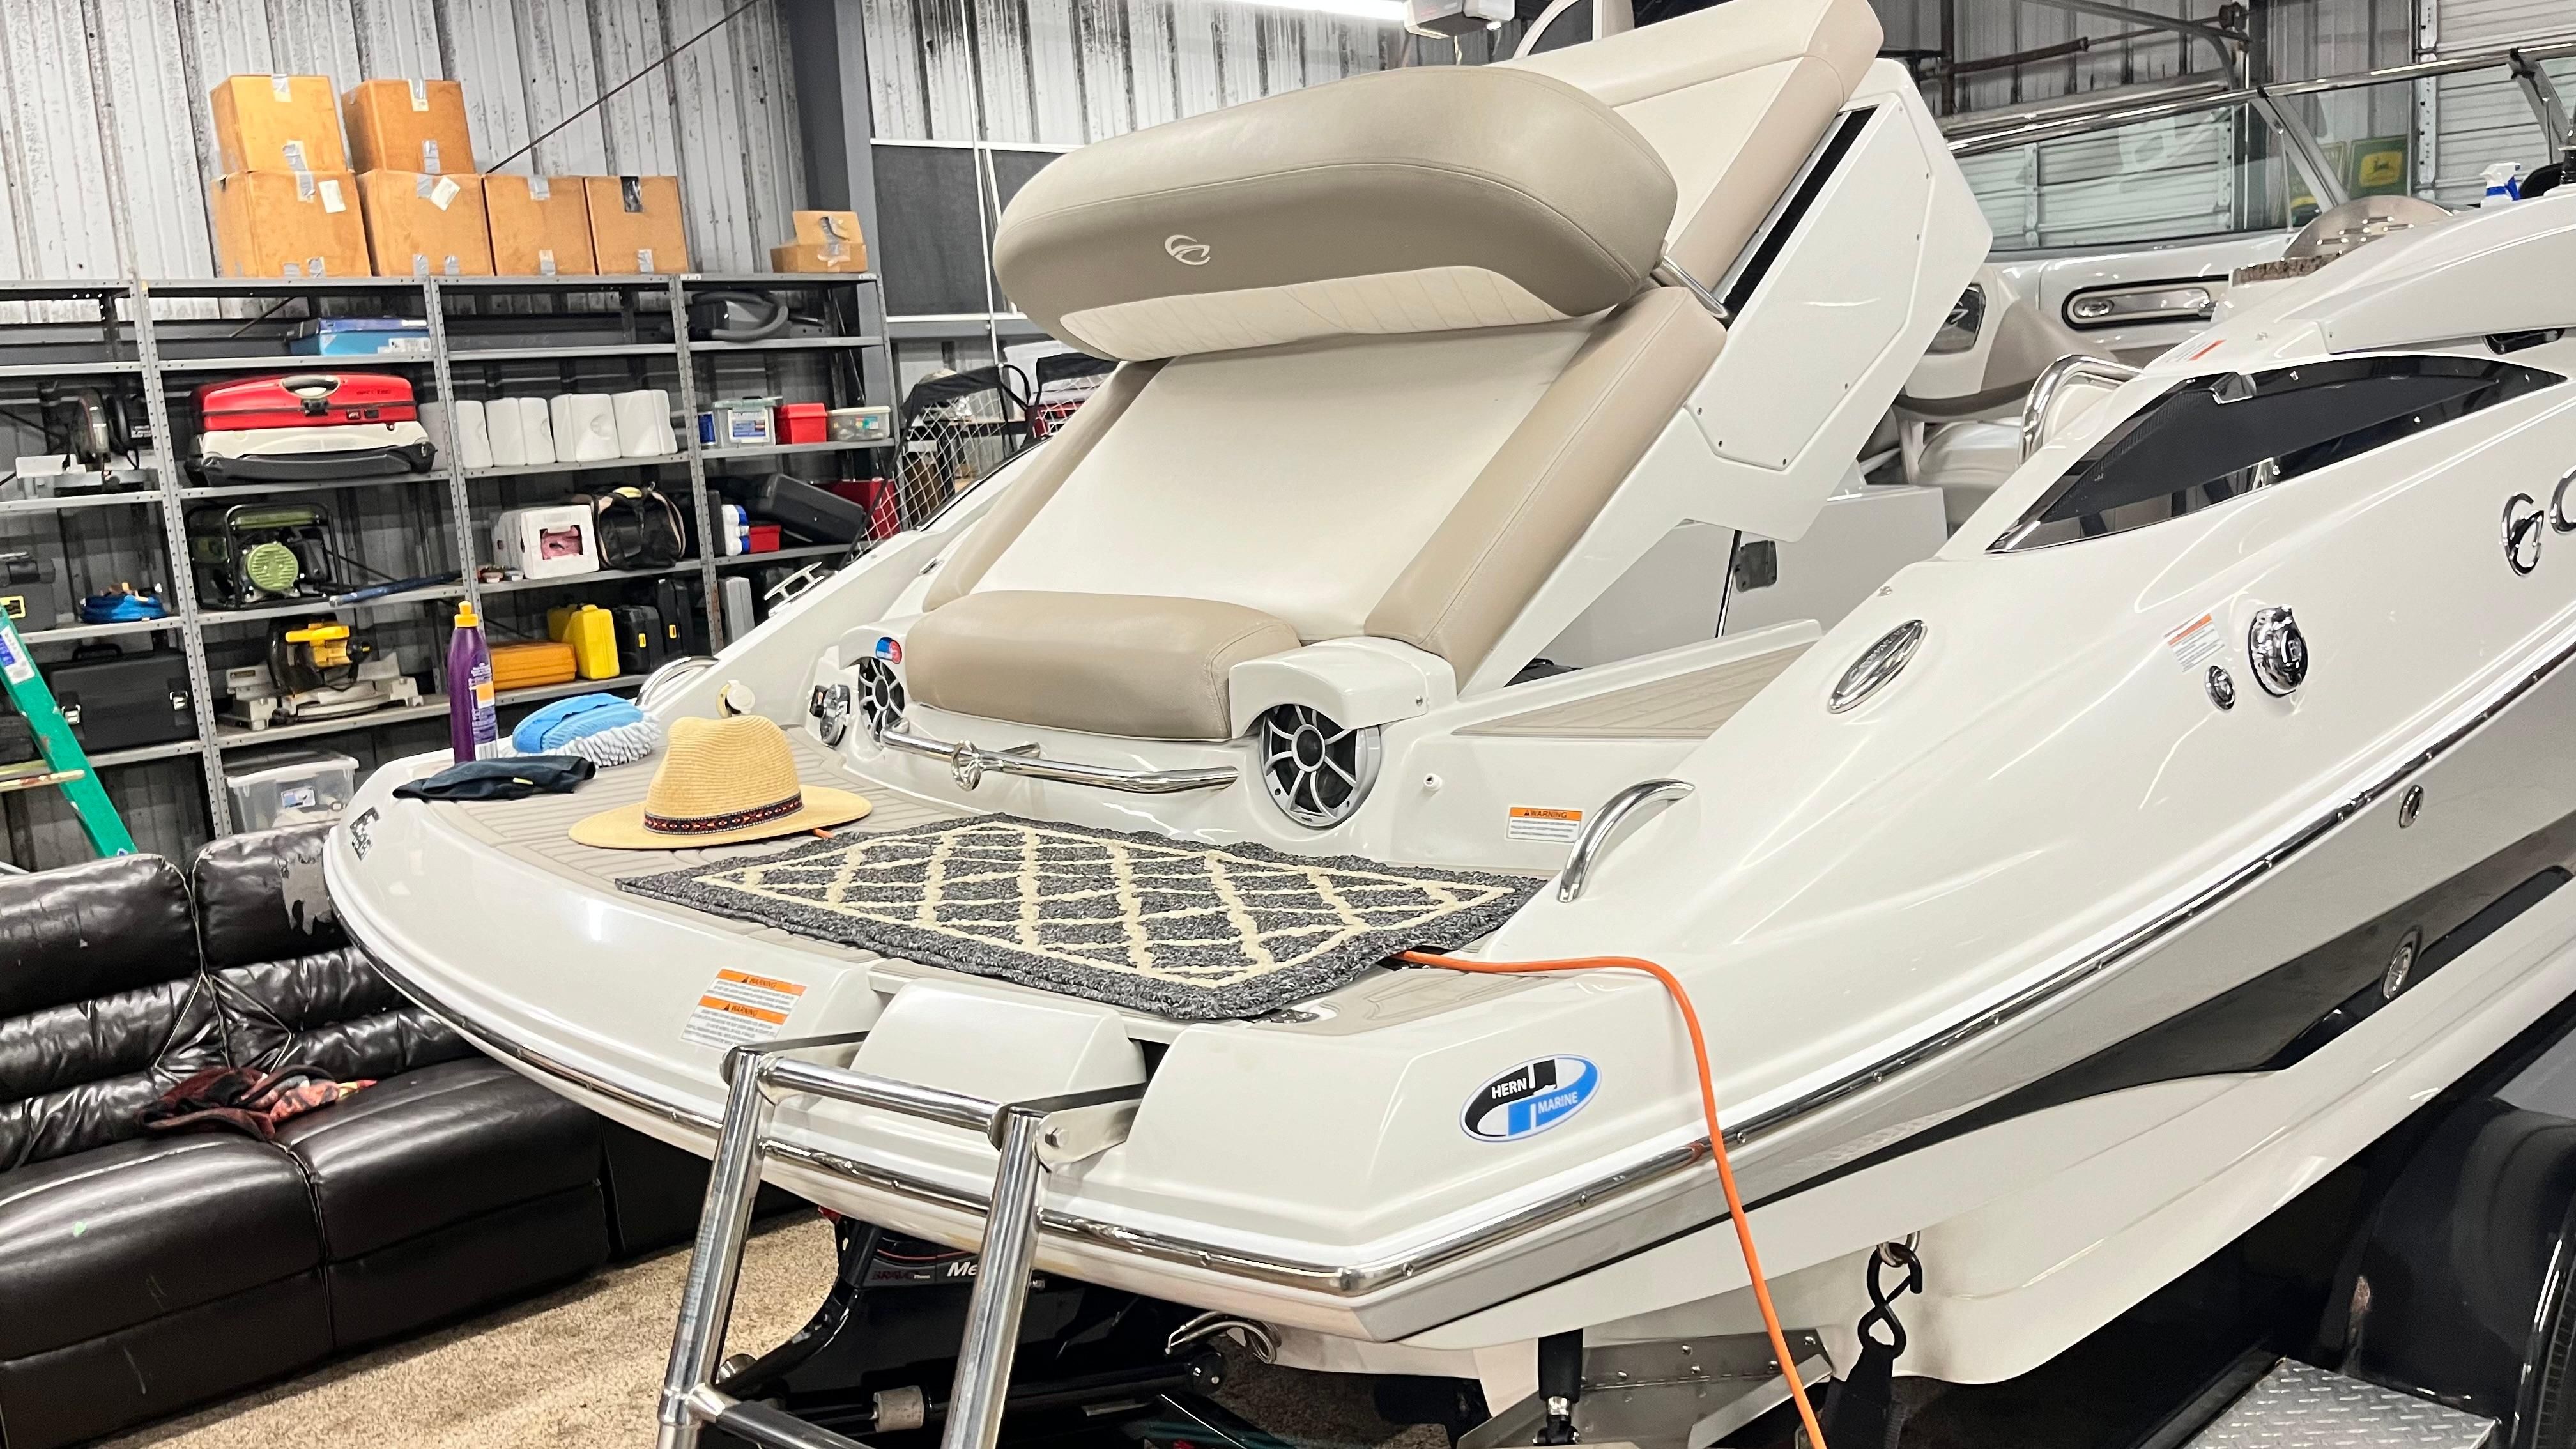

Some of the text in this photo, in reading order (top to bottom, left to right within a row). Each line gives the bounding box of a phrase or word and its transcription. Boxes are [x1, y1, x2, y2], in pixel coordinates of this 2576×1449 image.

[1531, 810, 1567, 818] WARNING
[748, 978, 778, 988] WARNING
[730, 1004, 759, 1017] WARNING
[1491, 1077, 1527, 1099] HERN
[1538, 1091, 1578, 1114] MARINE
